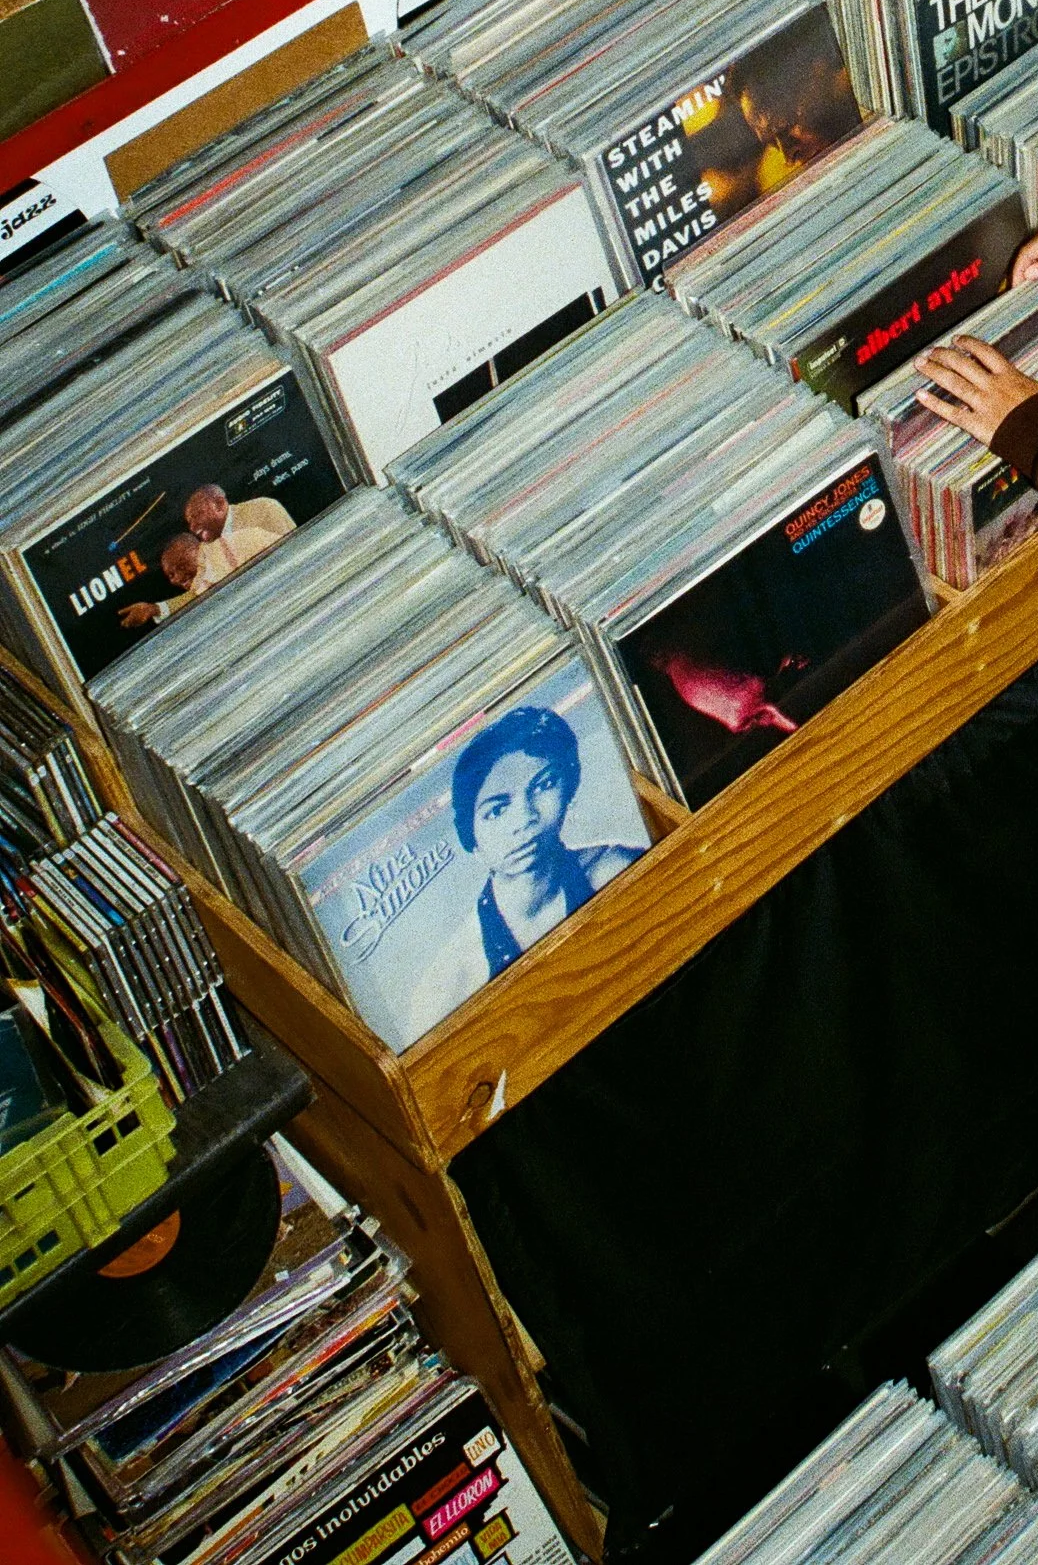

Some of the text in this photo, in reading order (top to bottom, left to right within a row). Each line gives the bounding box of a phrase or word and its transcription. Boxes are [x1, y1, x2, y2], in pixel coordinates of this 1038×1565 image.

[608, 75, 726, 168] STEAMIN'
[616, 139, 683, 195] WITH
[625, 174, 677, 218] THE
[1, 193, 57, 240] jazz
[633, 181, 713, 246] MILES
[642, 209, 718, 271] DAVIS
[856, 259, 982, 366] albert ayler
[785, 465, 871, 536] QUINCY JONES
[861, 475, 875, 488] THE
[792, 482, 879, 554] QUINTESSENCE
[69, 550, 148, 617] LIONEL
[340, 838, 454, 953] Simone
[352, 842, 418, 912] Nina
[467, 1431, 496, 1462] UNO
[429, 1469, 493, 1537] EL LLORON
